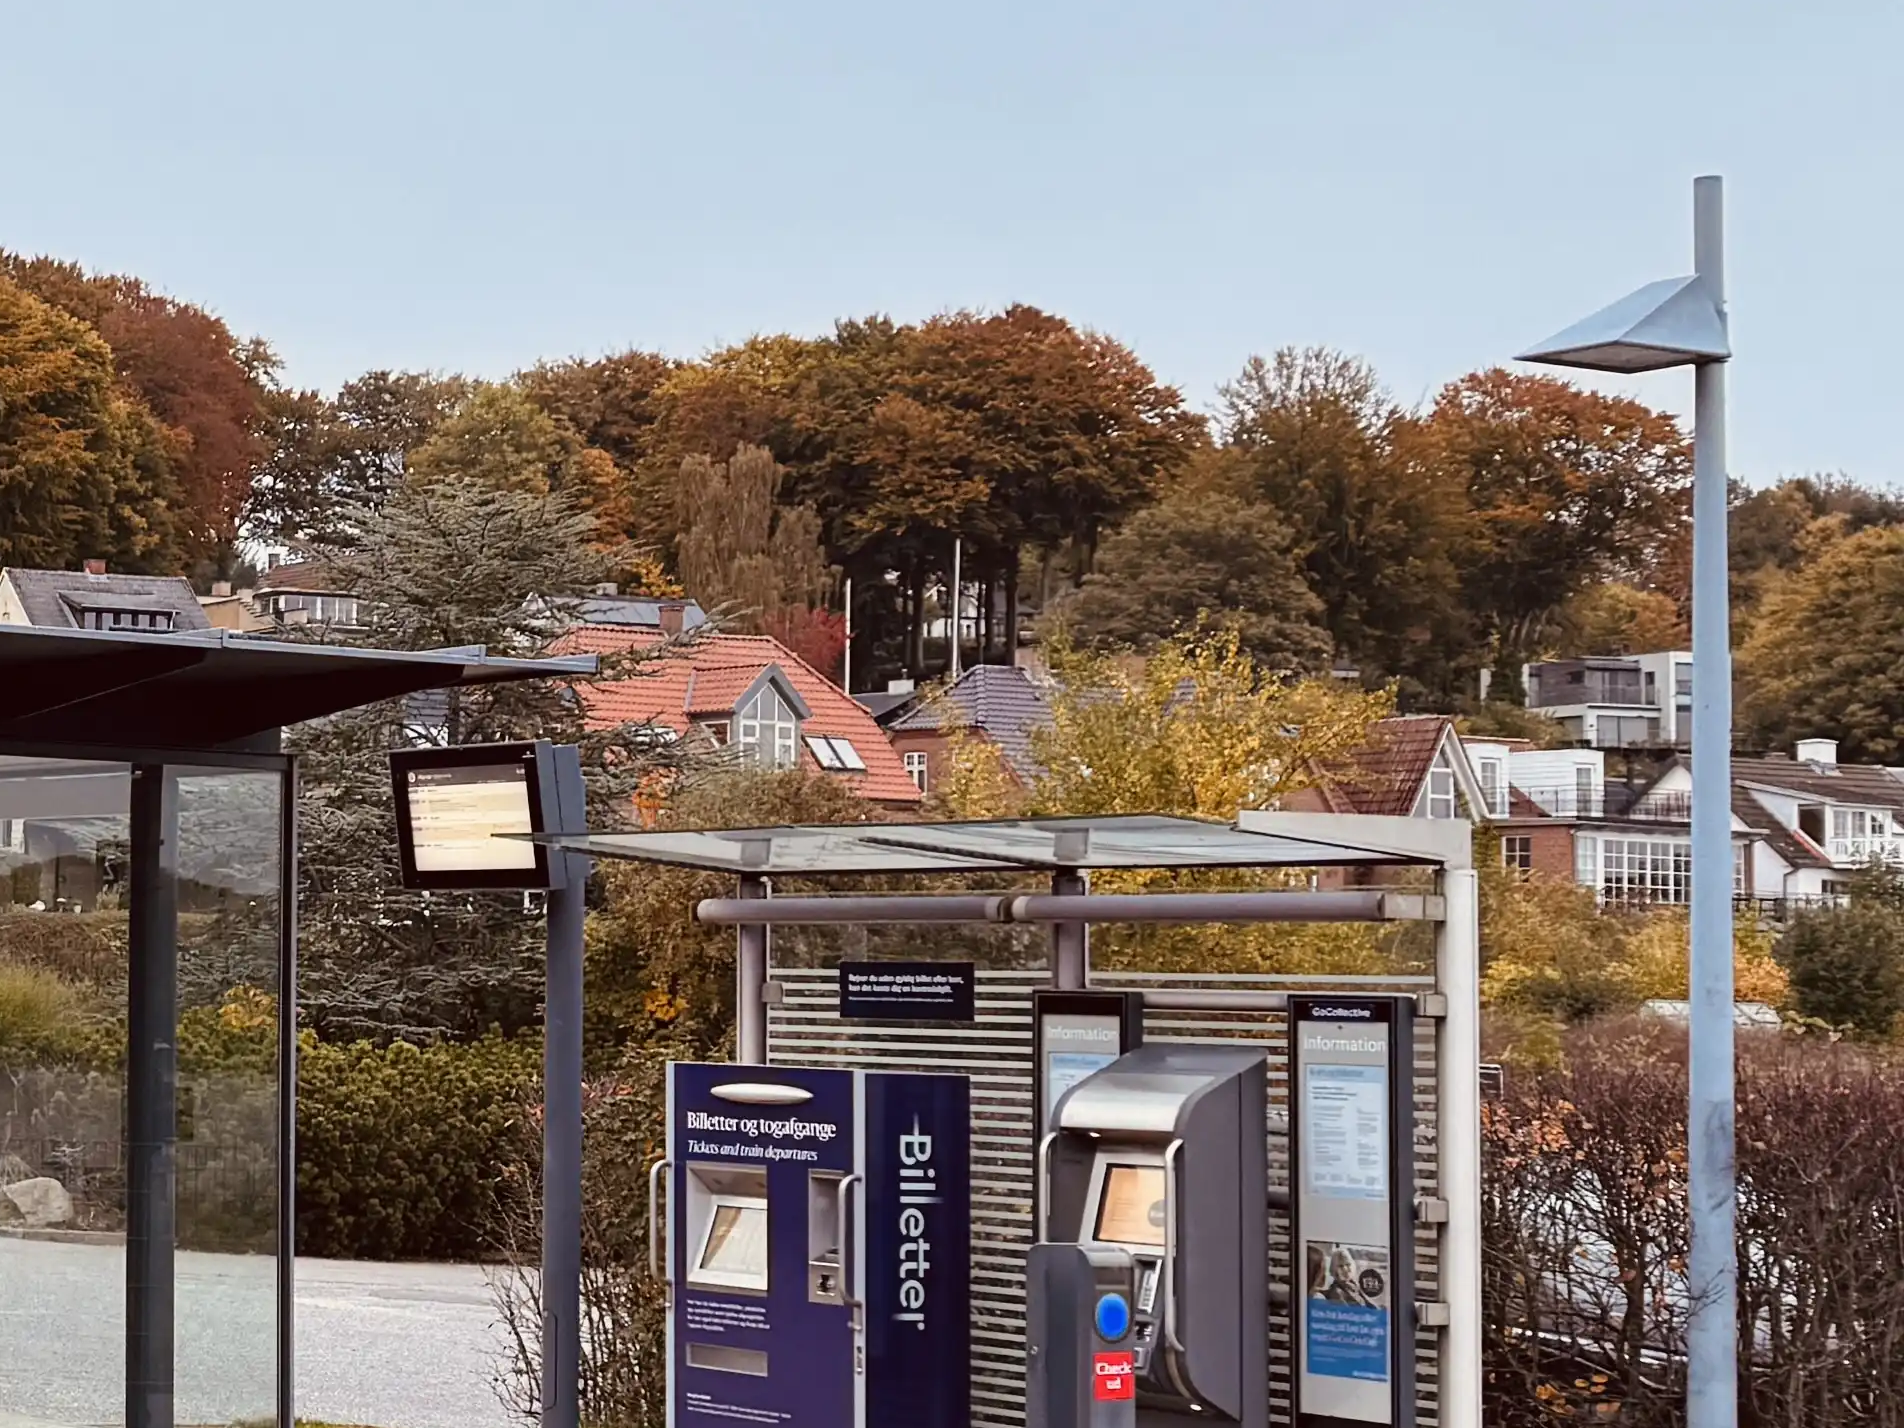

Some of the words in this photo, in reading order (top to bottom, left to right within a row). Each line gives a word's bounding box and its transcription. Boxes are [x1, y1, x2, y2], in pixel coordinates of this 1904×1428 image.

[1304, 1035, 1386, 1052] Information
[687, 1111, 738, 1131] Billetter
[740, 1119, 758, 1137] og
[760, 1117, 837, 1141] togafgange
[688, 1140, 719, 1155] Tickets
[720, 1143, 740, 1157] and
[741, 1143, 764, 1159] train
[765, 1145, 819, 1162] departures
[895, 1122, 941, 1331] Billetter
[1095, 1361, 1132, 1376] Check
